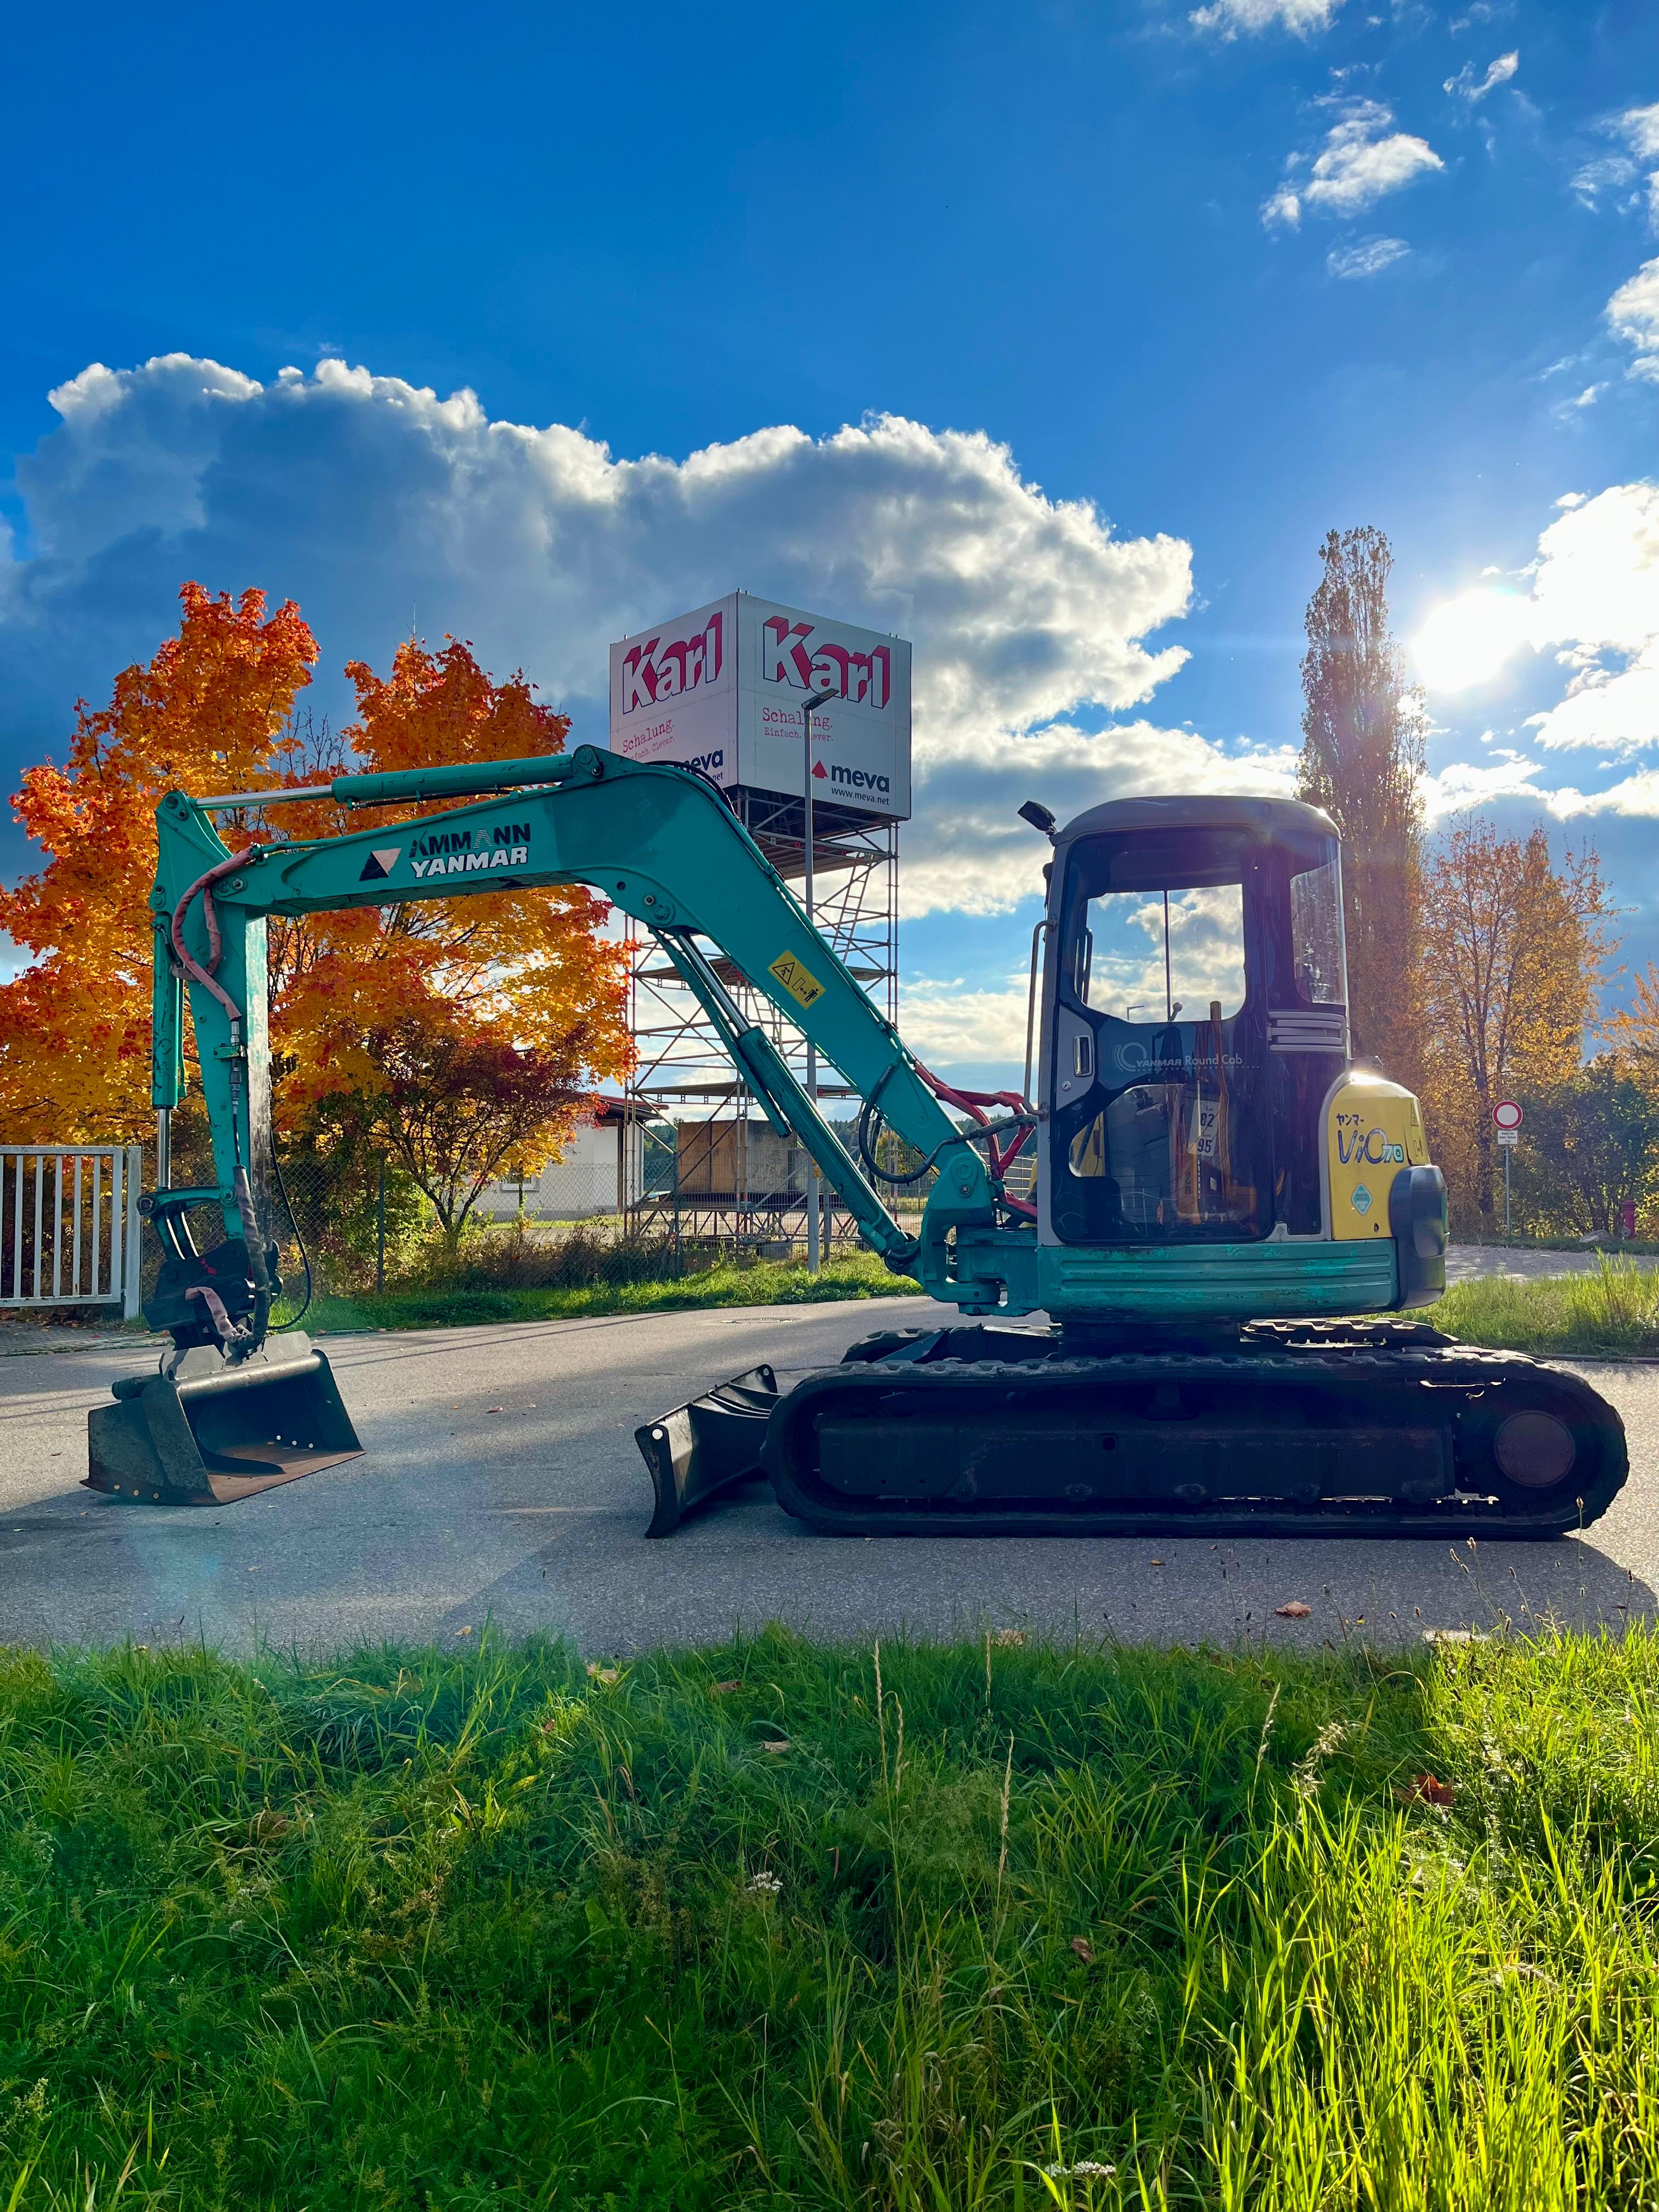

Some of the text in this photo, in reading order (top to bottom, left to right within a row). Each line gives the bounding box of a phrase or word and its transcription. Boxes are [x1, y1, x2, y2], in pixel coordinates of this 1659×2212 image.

[623, 611, 723, 714] Karl
[763, 616, 890, 709] Karl
[763, 707, 833, 731] Schalng.
[623, 719, 674, 753] Schalung.
[652, 736, 675, 752] Clever.
[764, 727, 802, 738] Einfach.
[684, 749, 723, 771] eva
[831, 765, 889, 793] meva
[831, 787, 889, 805] www.meva.net
[409, 823, 531, 858] AMMANN
[410, 847, 528, 878] YANMAR
[1136, 1053, 1243, 1067] YANMAR Round Cab
[1336, 1113, 1364, 1126] ヤンマー
